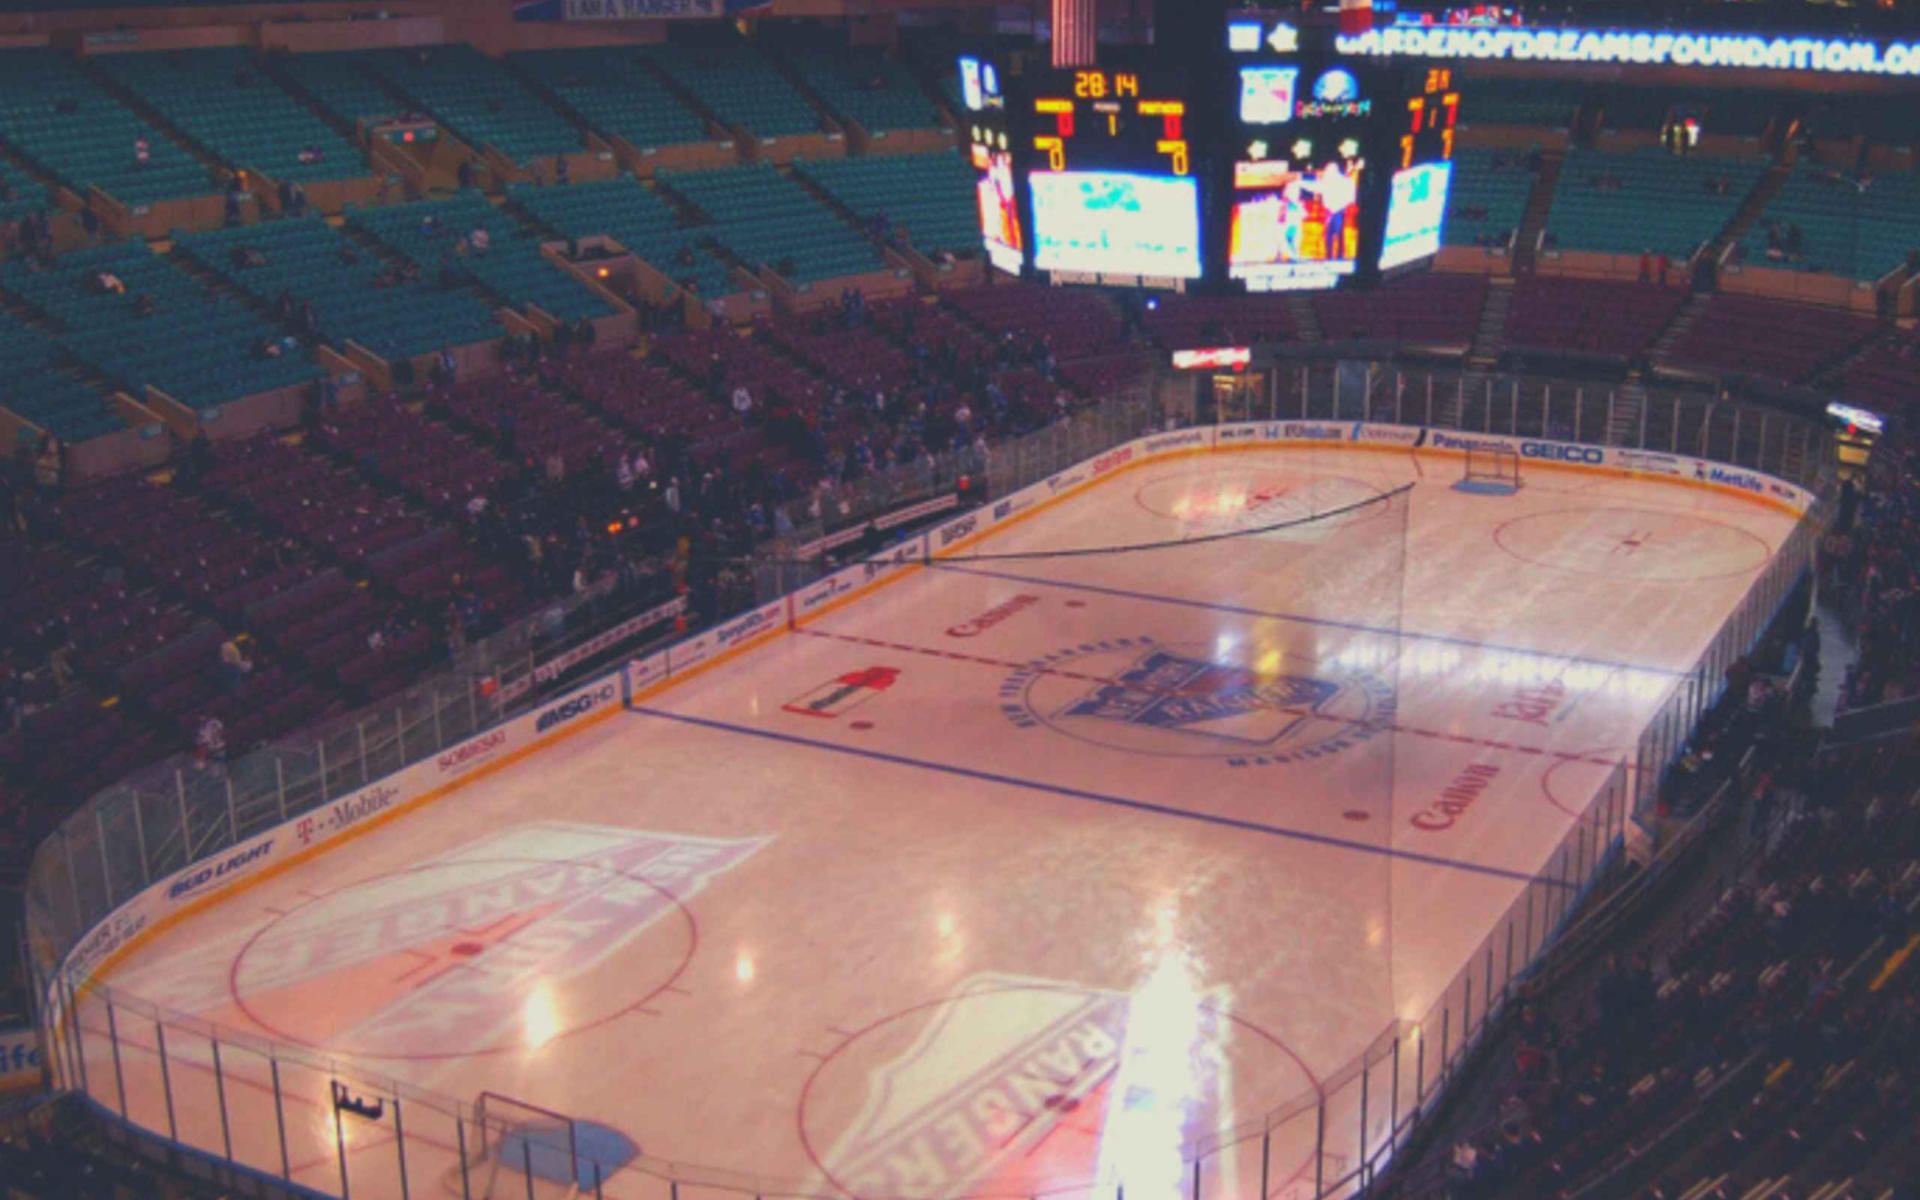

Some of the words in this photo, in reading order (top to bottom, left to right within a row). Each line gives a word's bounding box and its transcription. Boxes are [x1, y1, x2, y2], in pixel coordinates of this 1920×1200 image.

[1520, 442, 1604, 464] GEICO
[1710, 467, 1764, 492] MetLife
[1411, 763, 1500, 831] Canon
[215, 840, 275, 875] LIGHT
